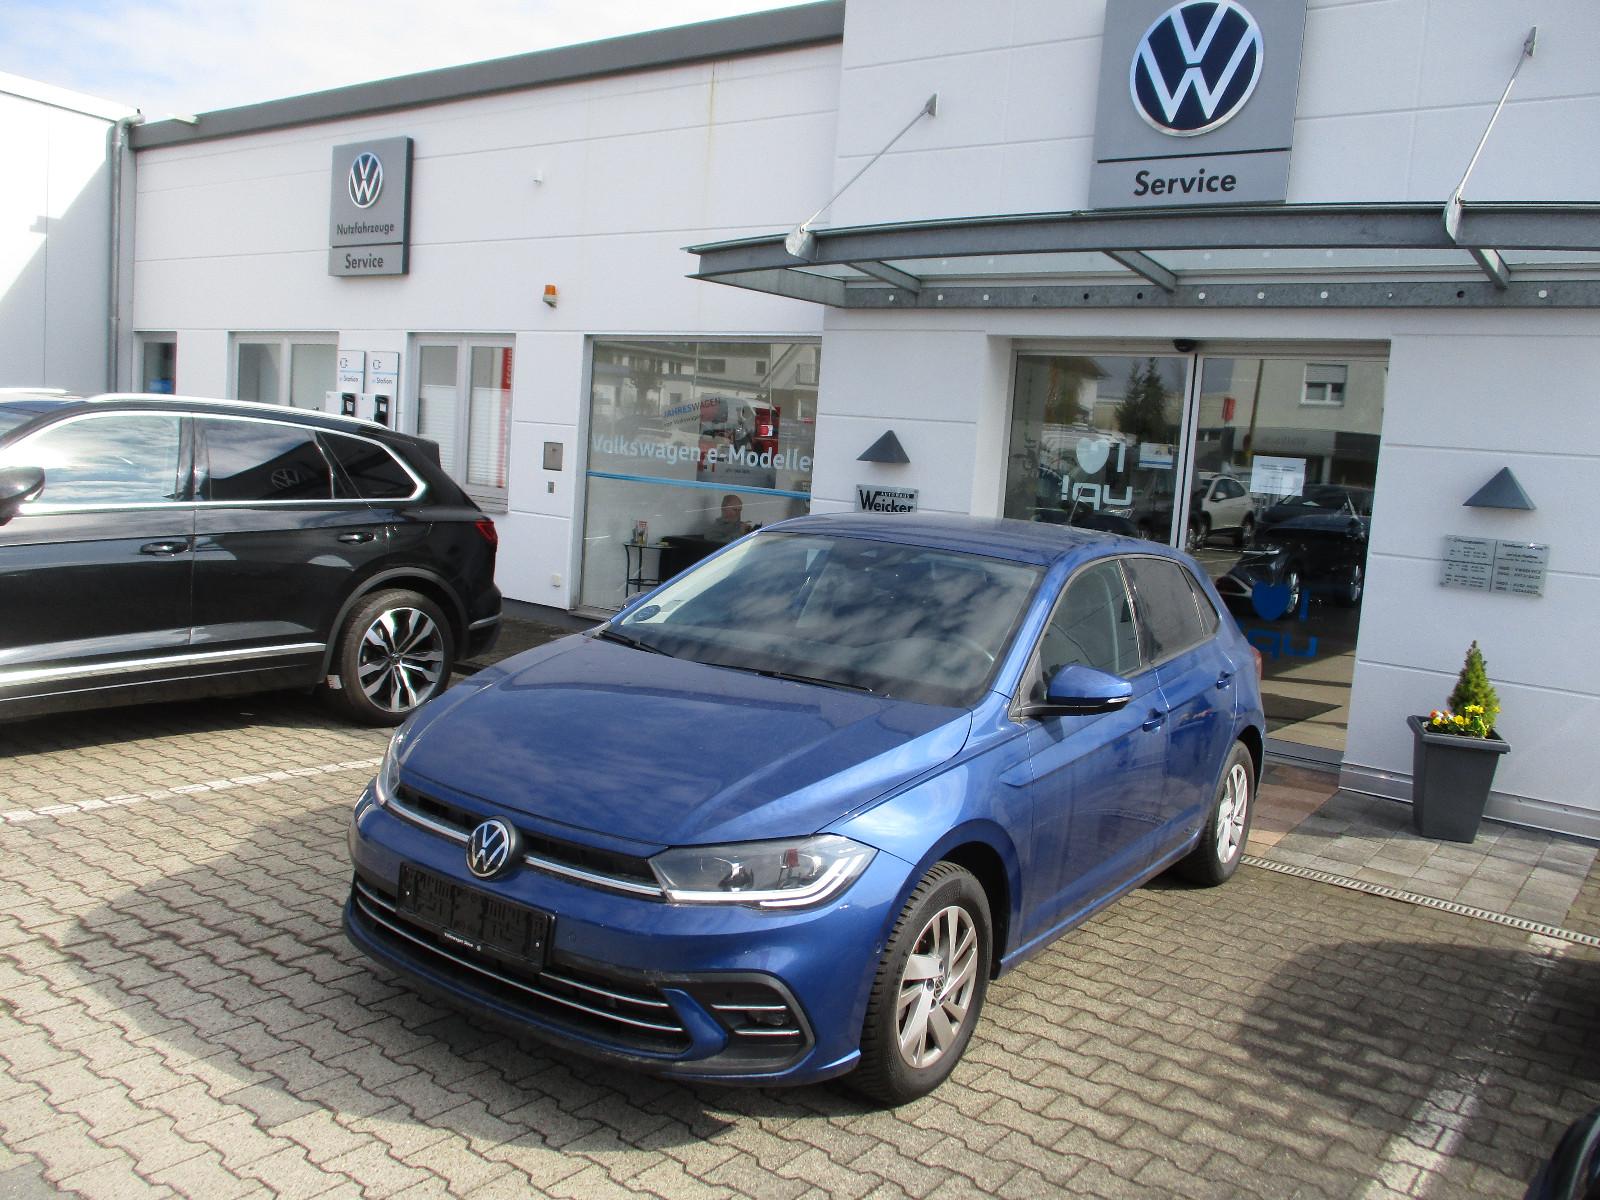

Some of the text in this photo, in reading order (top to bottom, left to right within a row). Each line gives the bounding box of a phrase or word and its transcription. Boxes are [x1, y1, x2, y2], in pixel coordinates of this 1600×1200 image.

[1130, 0, 1263, 137] VW
[349, 152, 383, 208] VW
[1133, 168, 1237, 196] Service
[336, 221, 395, 236] Nutzfahrzeuge
[345, 253, 384, 270] Service
[592, 432, 813, 473] Volkswagen e-Modelle
[859, 489, 914, 513] Weicker
[466, 820, 509, 877] VW
